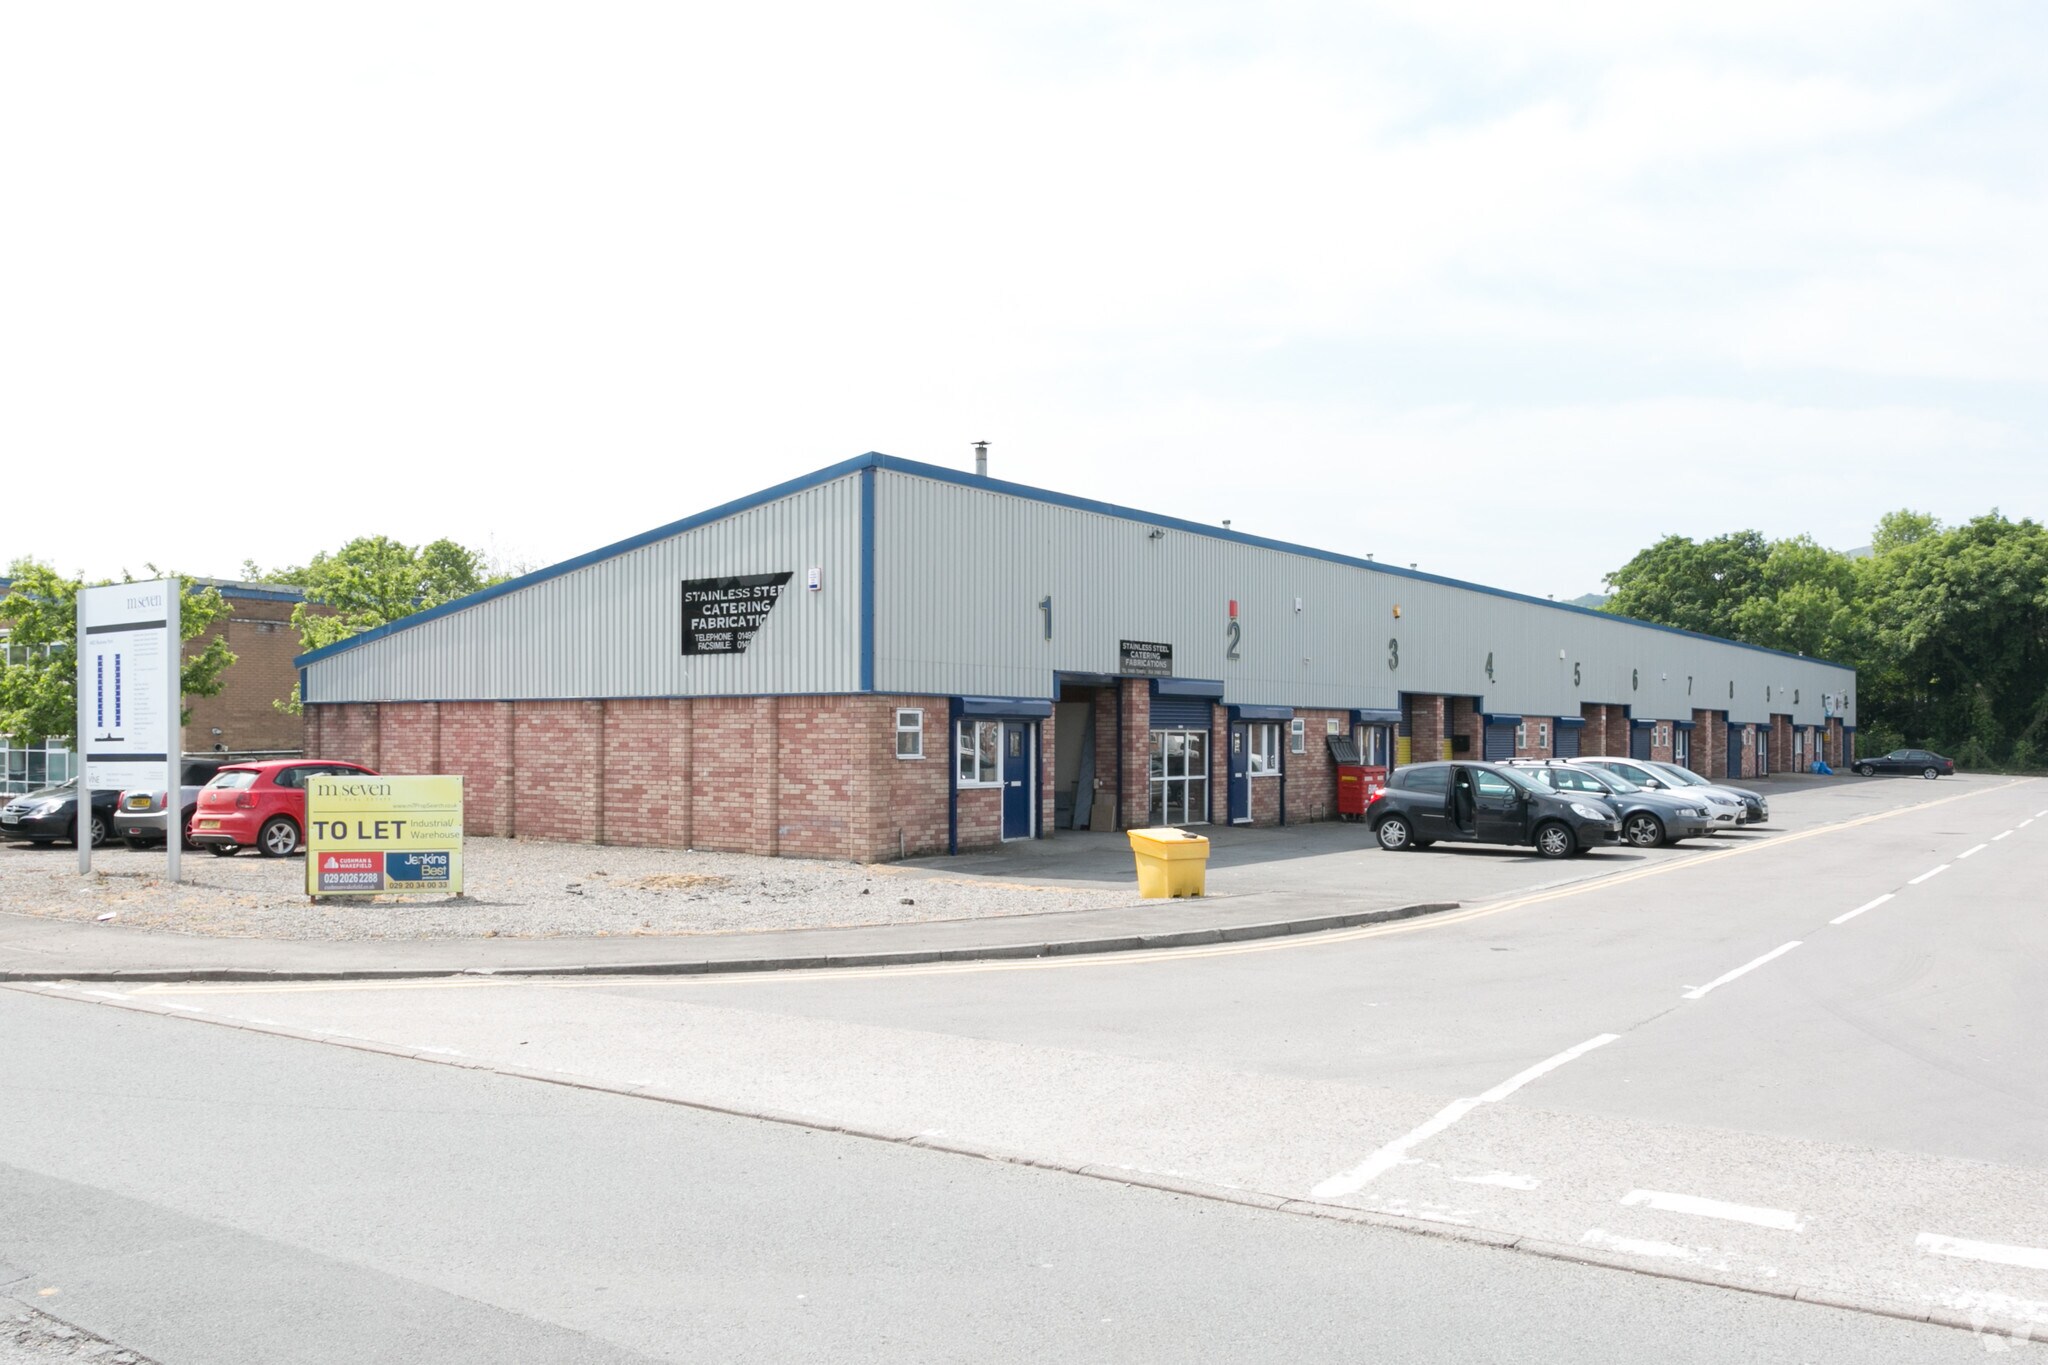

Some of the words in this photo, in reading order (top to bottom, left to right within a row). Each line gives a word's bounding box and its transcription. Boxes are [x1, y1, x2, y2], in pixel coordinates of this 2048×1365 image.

[685, 588, 750, 602] STAINLESS
[702, 600, 771, 615] CATERING
[1038, 595, 1052, 641] 1
[694, 632, 733, 642] TELEPHONE:
[1226, 621, 1241, 660] 2
[697, 641, 731, 650] FACSIMILE:
[1122, 642, 1152, 651] STAINLESS
[1152, 644, 1169, 653] STEEL
[1130, 651, 1161, 660] CATERING
[1388, 638, 1399, 672] 3
[1125, 659, 1167, 668] FABRICATIONS
[1485, 652, 1494, 680] 4
[1574, 662, 1581, 687] 5
[1632, 668, 1639, 691] 6
[1688, 676, 1692, 696] 7
[318, 784, 338, 797] m
[341, 784, 392, 797] seven
[312, 820, 348, 840] TO
[358, 820, 407, 840] LET
[410, 831, 460, 839] Warehouse
[404, 853, 447, 865] Jenkins
[422, 864, 447, 876] Best
[324, 873, 339, 884] 029
[340, 873, 358, 883] 2026
[358, 872, 378, 883] 2288
